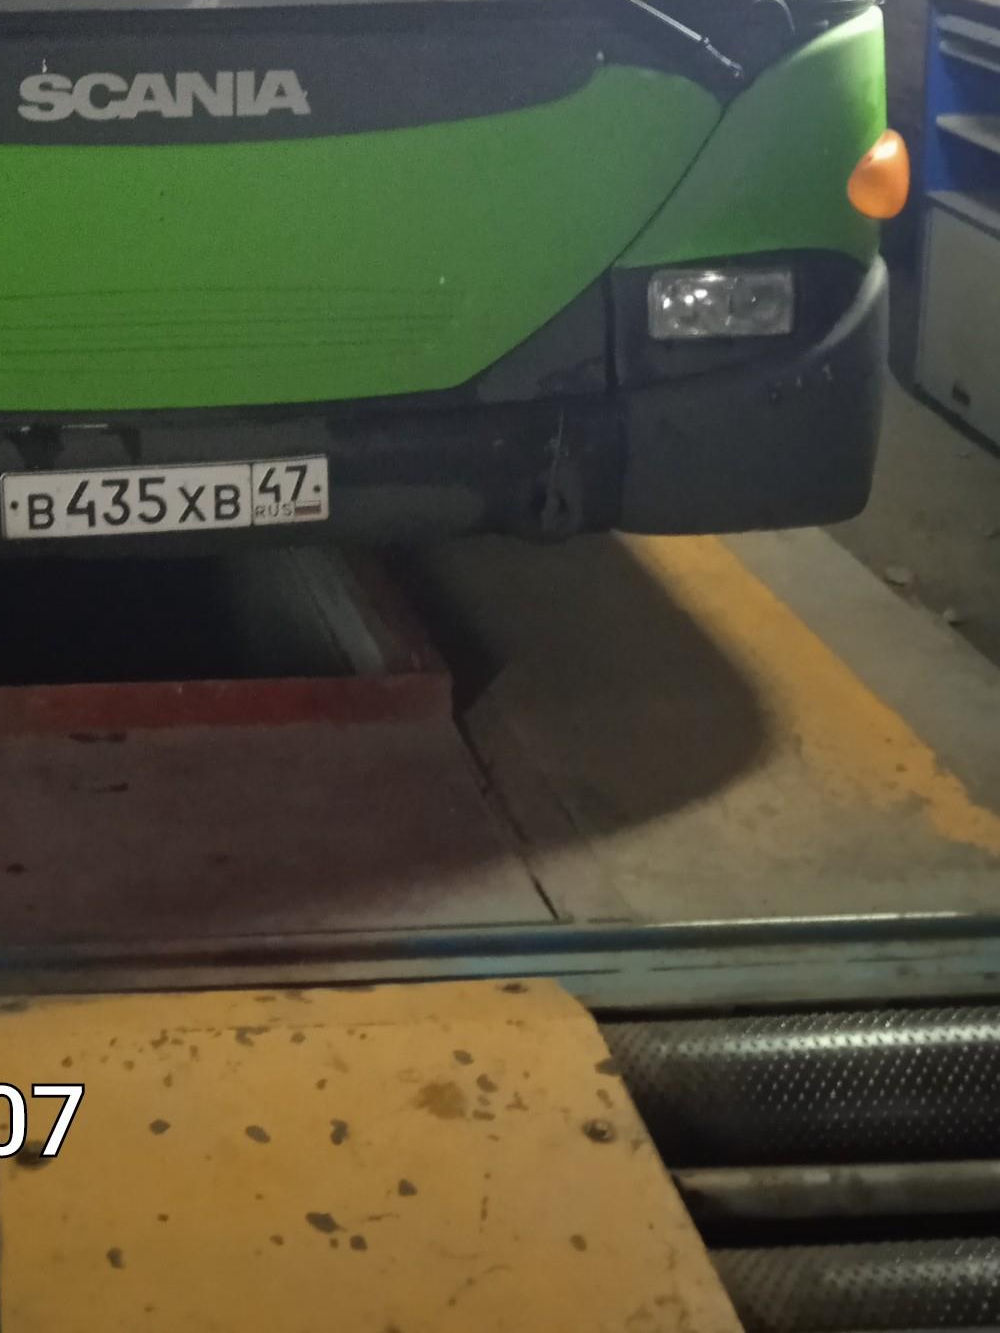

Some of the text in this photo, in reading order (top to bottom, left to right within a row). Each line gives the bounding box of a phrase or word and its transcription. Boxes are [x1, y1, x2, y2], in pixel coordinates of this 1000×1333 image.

[17, 69, 311, 122] SCANIA
[258, 464, 308, 503] 47
[254, 502, 294, 518] RUS
